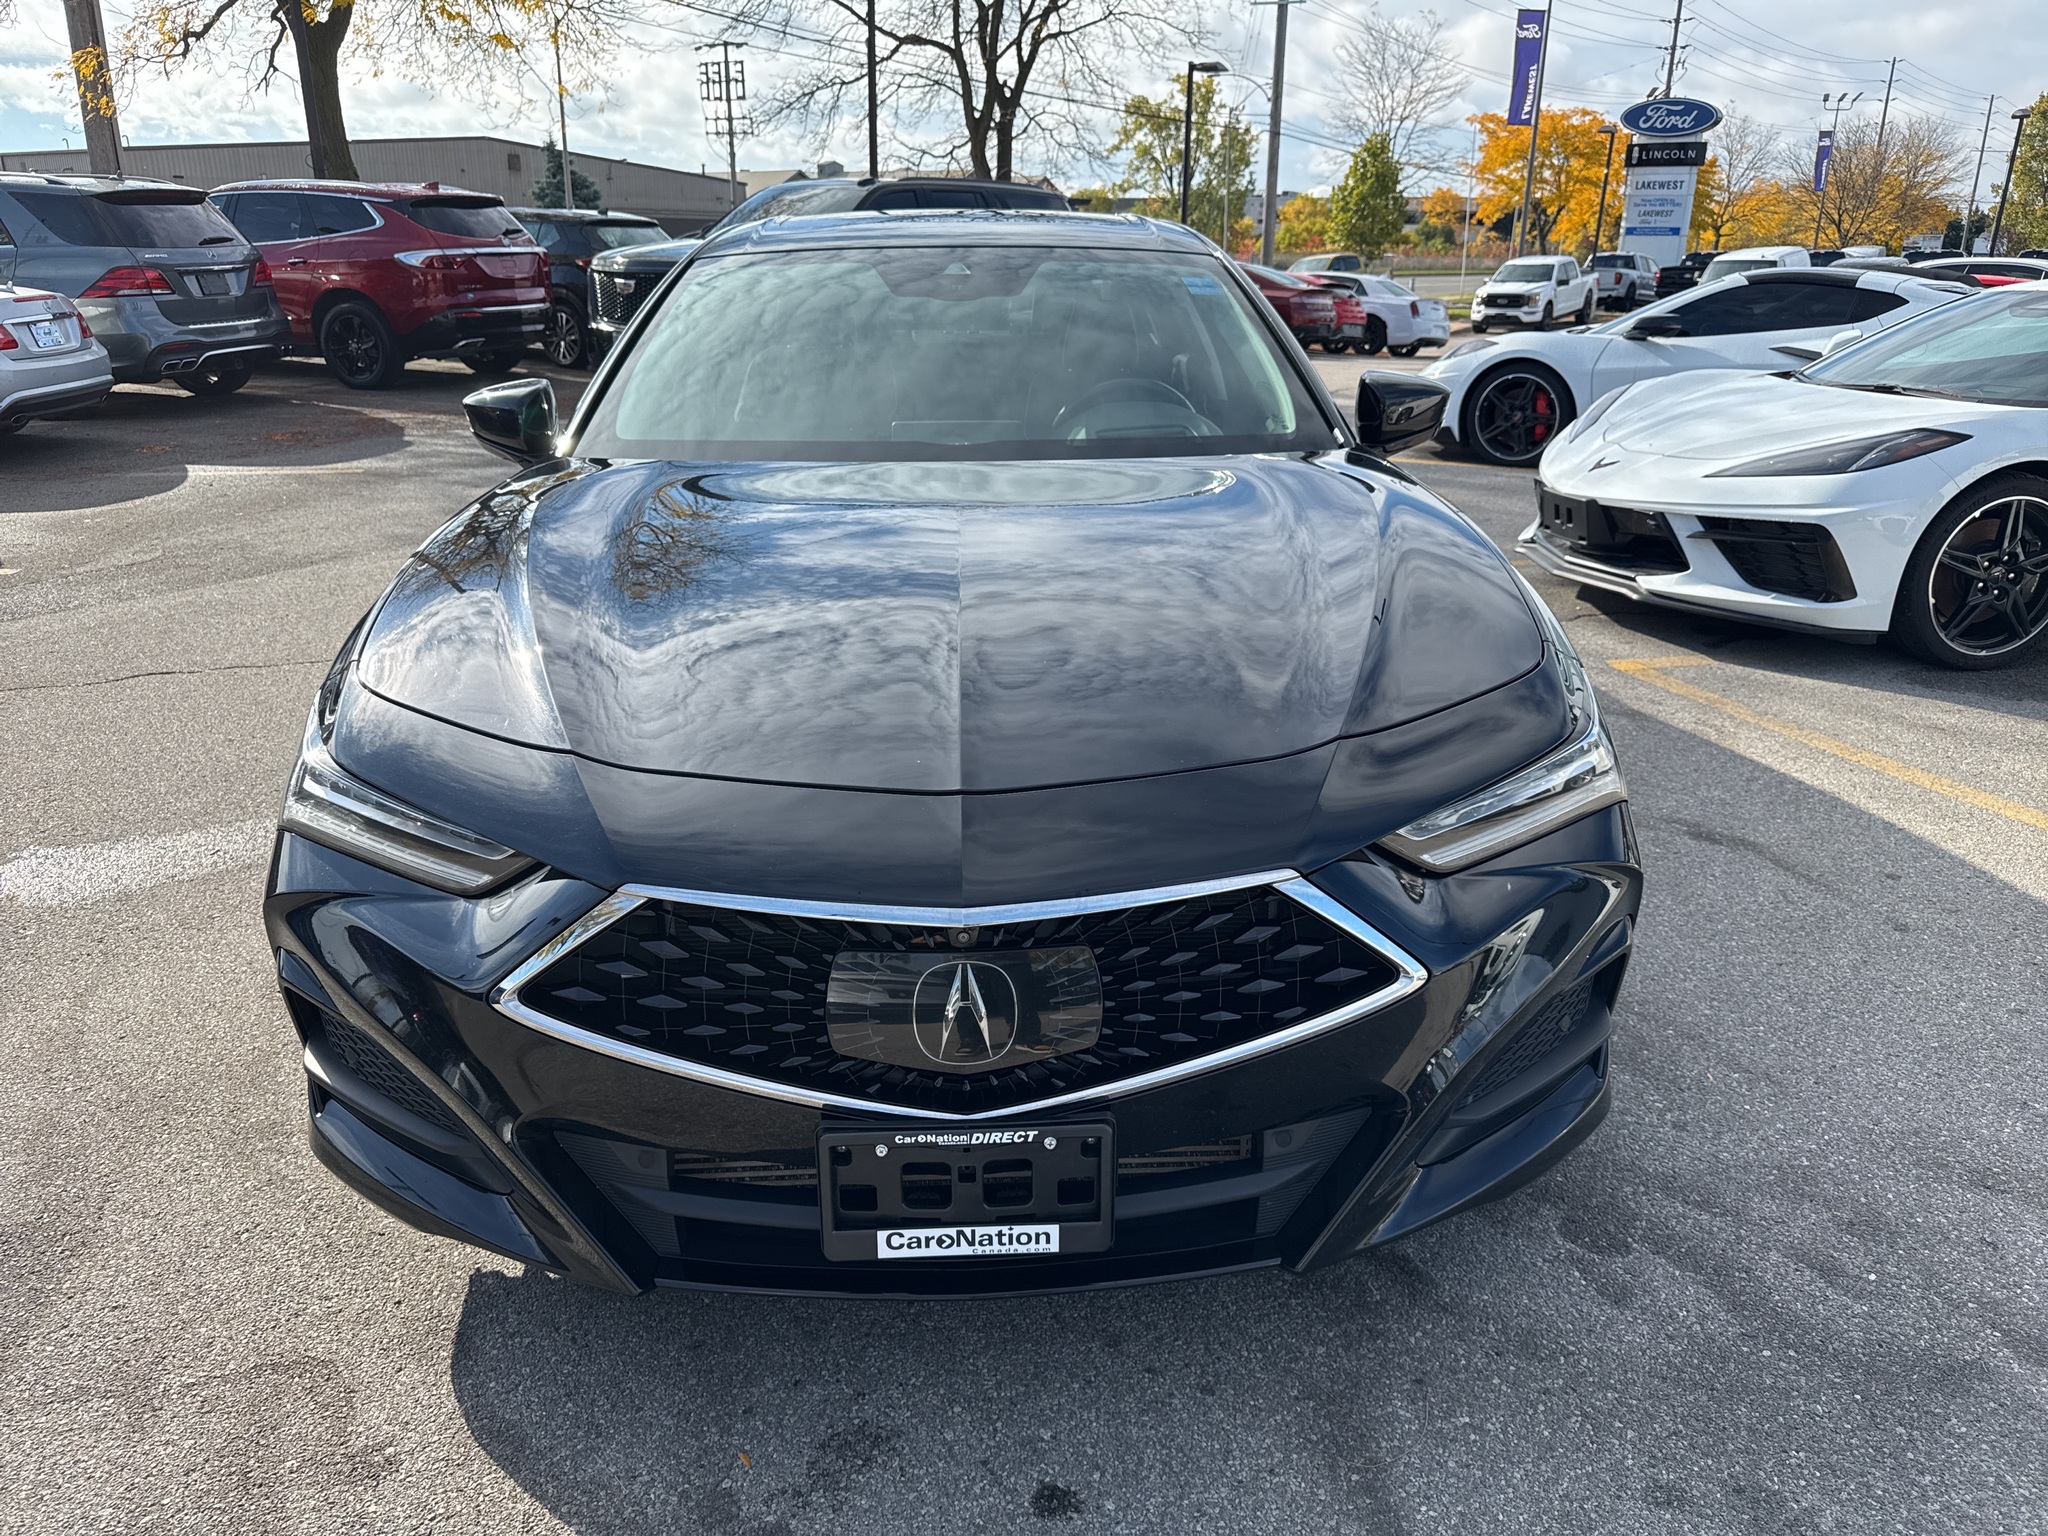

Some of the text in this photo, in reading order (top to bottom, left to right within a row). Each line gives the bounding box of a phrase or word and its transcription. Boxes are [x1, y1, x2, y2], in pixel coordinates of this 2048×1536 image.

[1639, 104, 1698, 129] Ford
[1641, 149, 1697, 160] LINCOLN
[1635, 180, 1685, 190] LAKEWEST
[1637, 209, 1674, 218] LAKEWEST
[970, 1130, 1039, 1144] DIRECT
